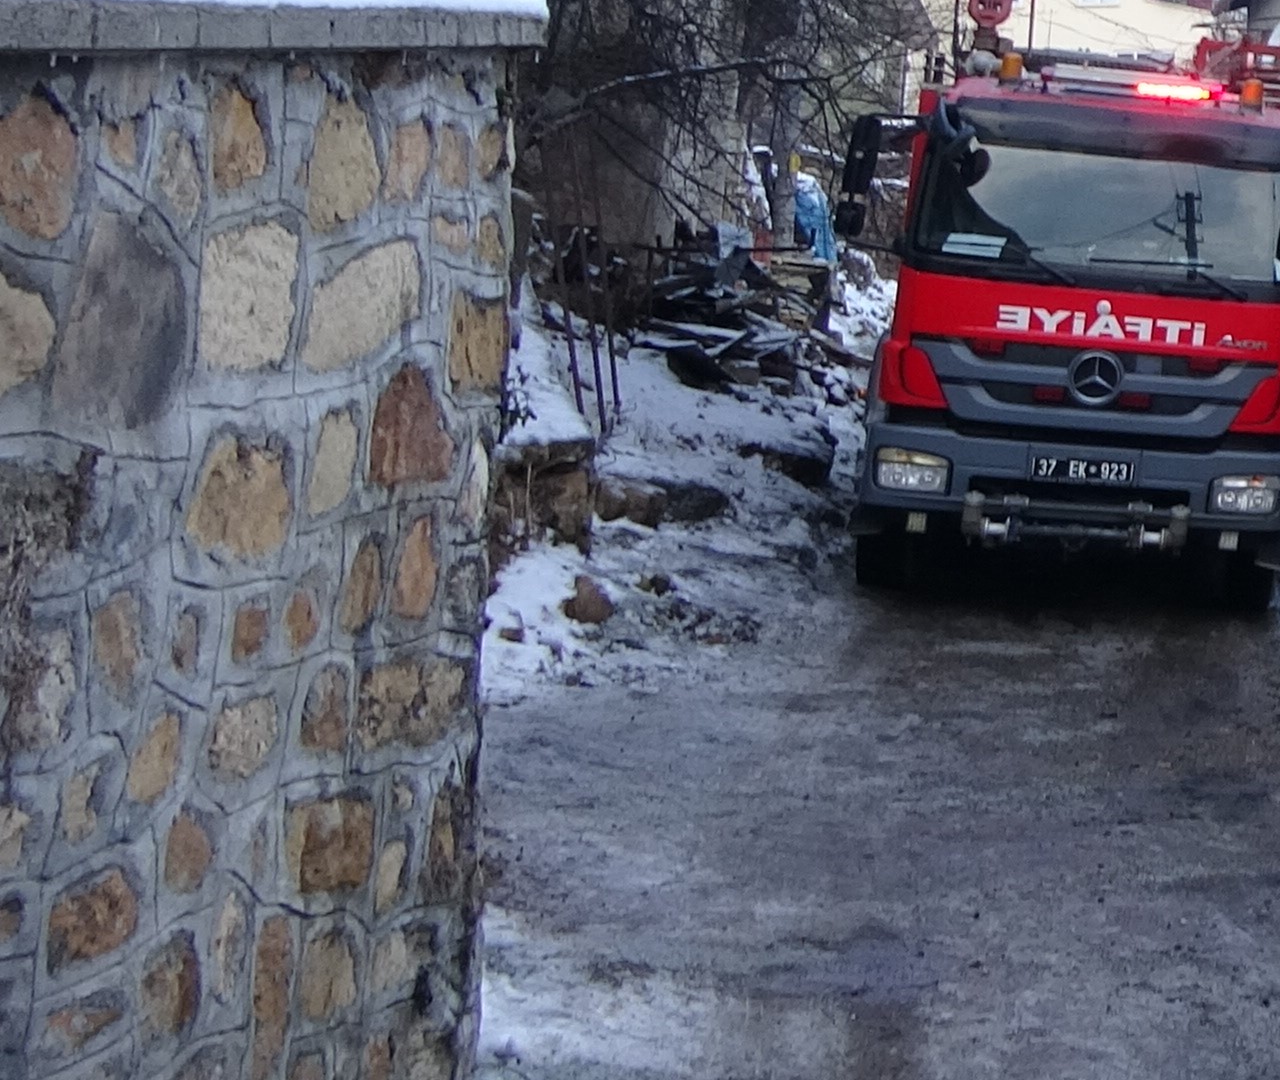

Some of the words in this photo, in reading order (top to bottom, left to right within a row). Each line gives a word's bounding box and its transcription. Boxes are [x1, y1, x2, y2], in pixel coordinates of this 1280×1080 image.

[1038, 458, 1057, 476] 37
[1069, 459, 1088, 479] EK
[1100, 461, 1128, 480] 923
